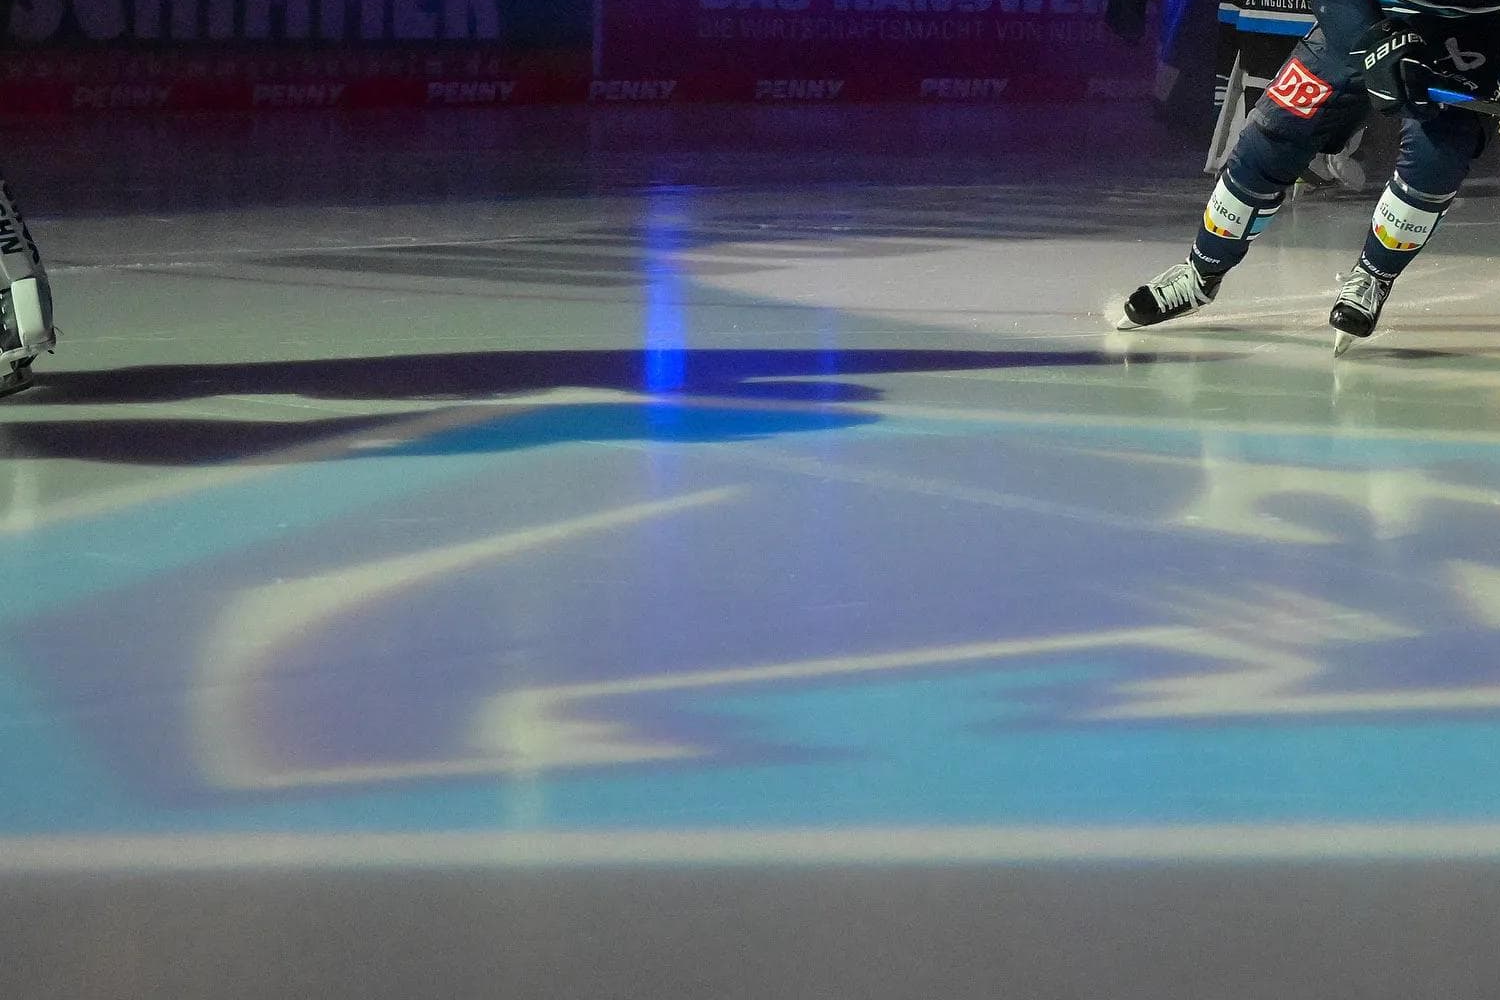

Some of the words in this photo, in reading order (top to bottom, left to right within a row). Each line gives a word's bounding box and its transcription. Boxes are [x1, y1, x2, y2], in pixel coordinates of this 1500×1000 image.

[697, 13, 735, 38] DIE
[739, 14, 991, 41] WIRTSCHAFTSMACHT
[995, 17, 1042, 42] VON
[252, 80, 346, 105] PENNY
[426, 79, 517, 103] PENNY
[588, 78, 678, 102] PENNY
[755, 78, 846, 100] PENNY
[920, 76, 1010, 98] PENNY
[1272, 64, 1323, 109] DB
